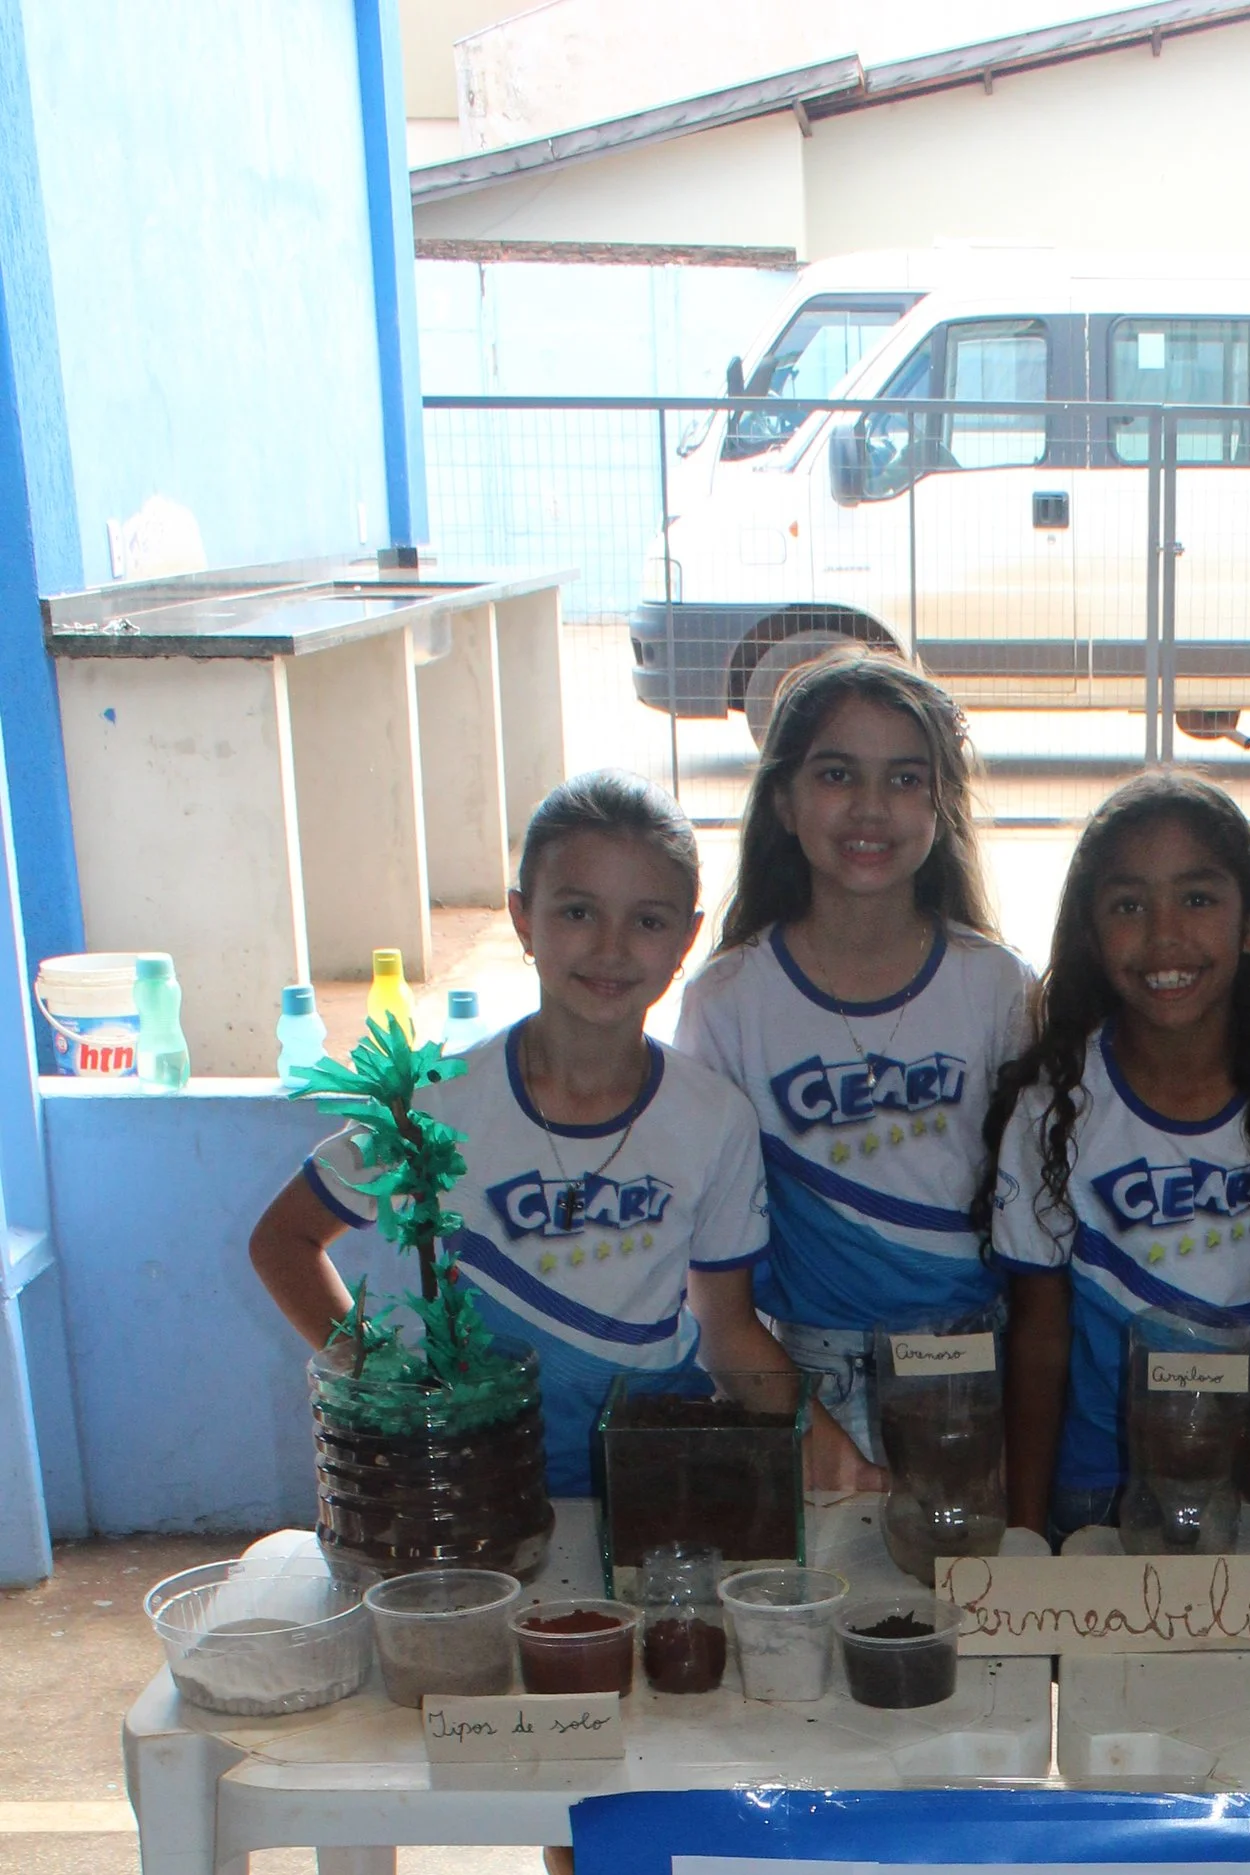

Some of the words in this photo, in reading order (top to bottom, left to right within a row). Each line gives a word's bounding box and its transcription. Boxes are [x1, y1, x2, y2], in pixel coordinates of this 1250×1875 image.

[784, 1055, 968, 1121] CEART
[429, 1710, 498, 1743] Tipos
[512, 1710, 535, 1733] de
[550, 1712, 611, 1733] solo
